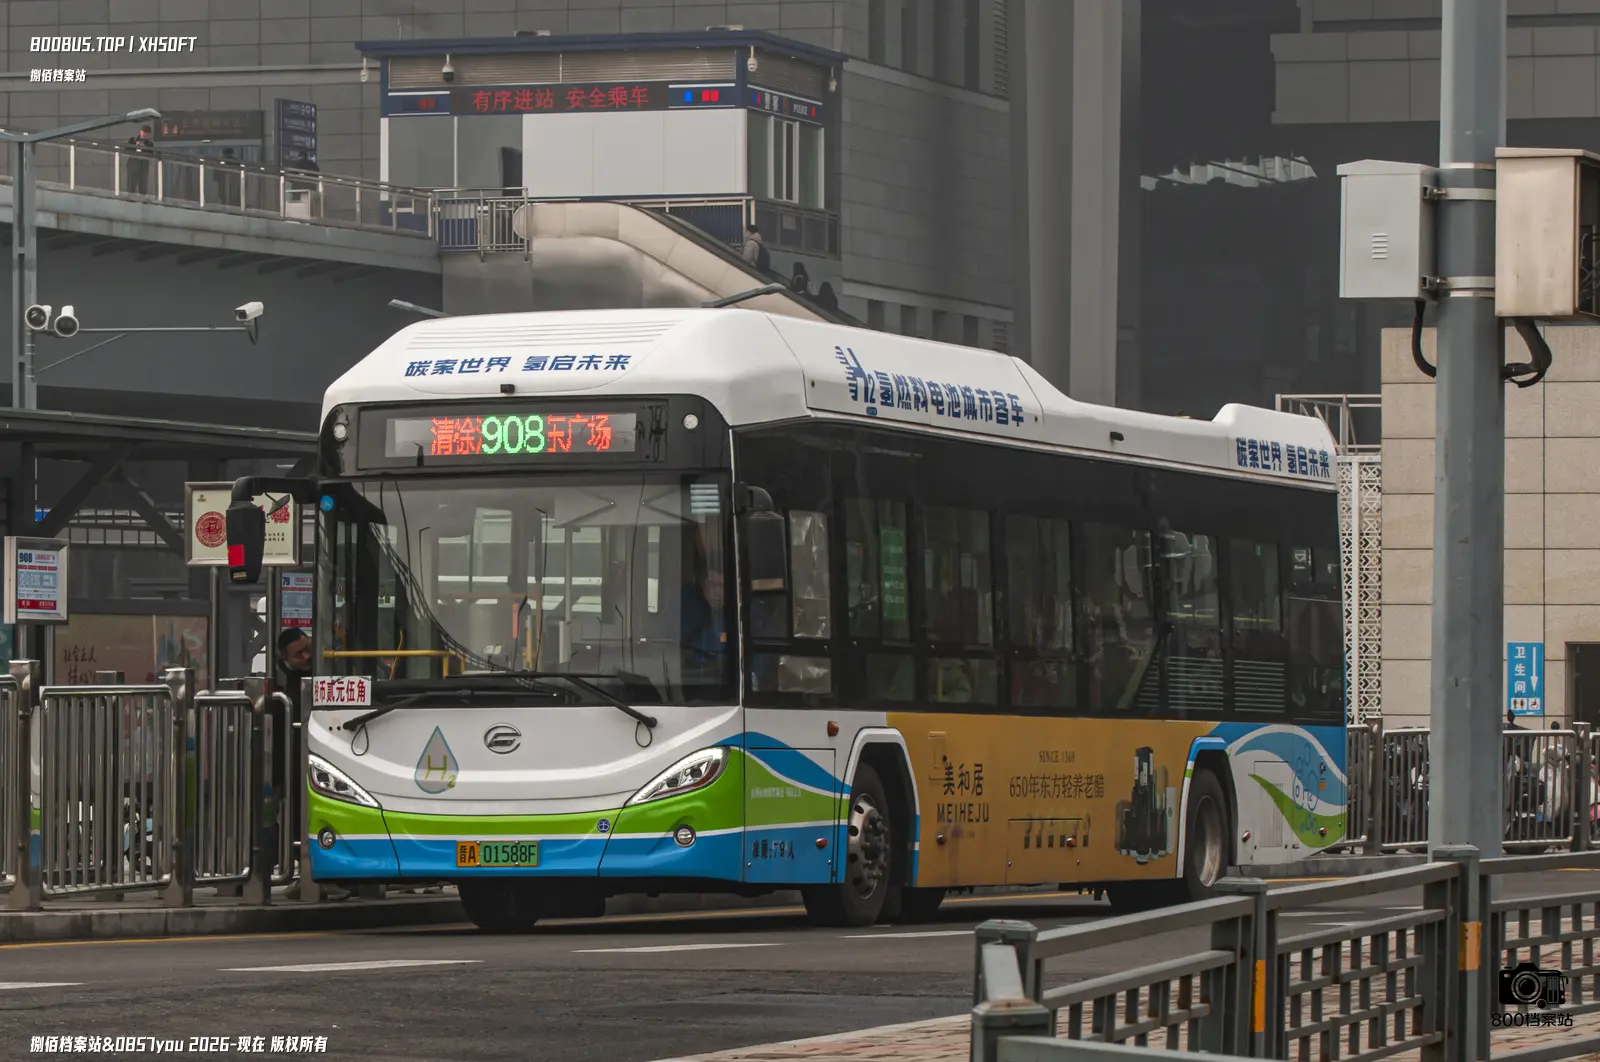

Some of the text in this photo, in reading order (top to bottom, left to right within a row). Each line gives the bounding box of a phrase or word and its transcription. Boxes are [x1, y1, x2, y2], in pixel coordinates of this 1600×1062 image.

[472, 85, 649, 112] 有序进站 安全乘车
[404, 354, 632, 377] 碳索世界 氢启未来
[873, 370, 1025, 427] 氢燃料电池城市客车
[1286, 443, 1330, 478] 氢启未来
[19, 552, 33, 563] 908
[1514, 646, 1526, 693] 卫生间
[1039, 750, 1059, 763] SINCE
[943, 762, 984, 796] 美和居
[1009, 773, 1105, 799] 650年东方轻养老醋
[937, 803, 989, 823] MEIHEJU
